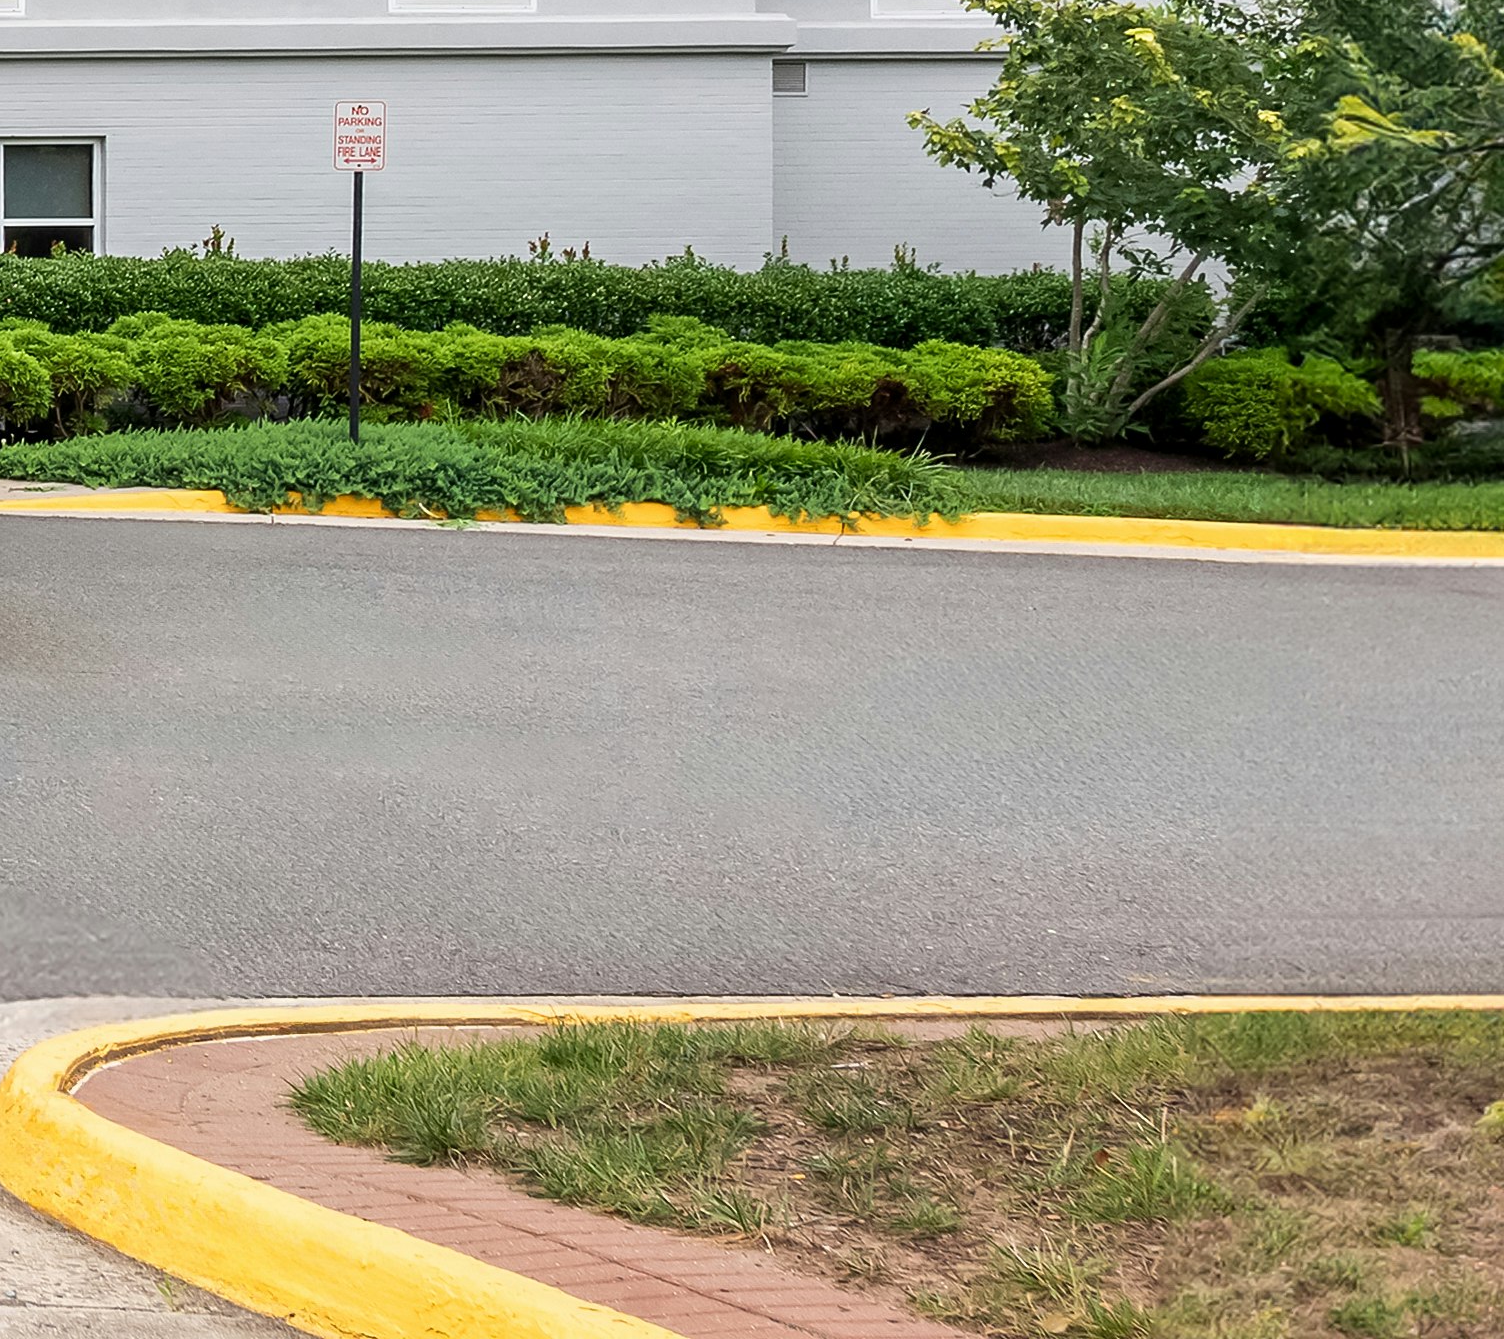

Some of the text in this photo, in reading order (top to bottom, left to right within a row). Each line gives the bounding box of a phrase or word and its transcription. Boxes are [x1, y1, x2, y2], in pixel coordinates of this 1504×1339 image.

[351, 107, 369, 115] NO
[338, 117, 382, 126] PARKING
[338, 135, 381, 144] STANDING
[337, 146, 381, 157] FIRE LANE
